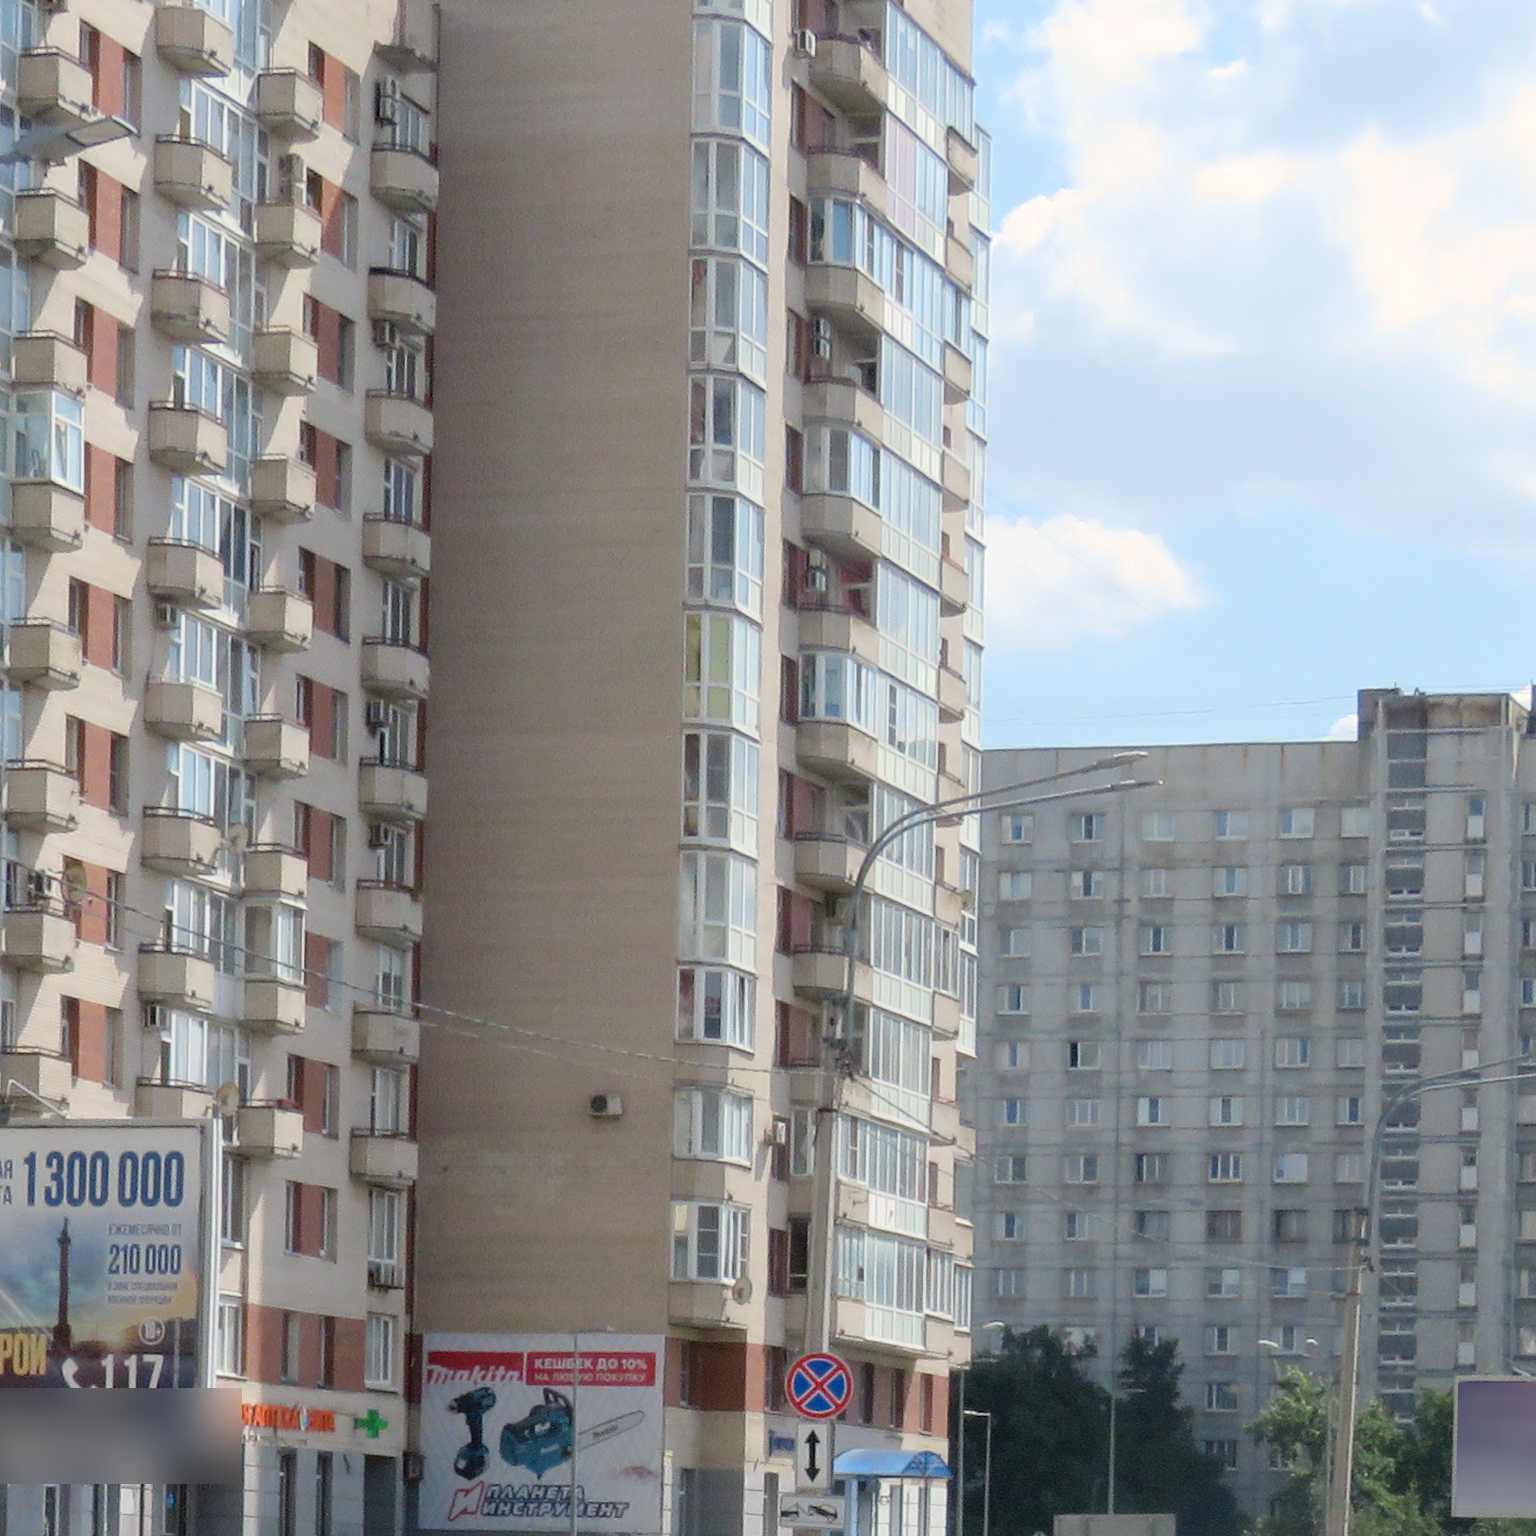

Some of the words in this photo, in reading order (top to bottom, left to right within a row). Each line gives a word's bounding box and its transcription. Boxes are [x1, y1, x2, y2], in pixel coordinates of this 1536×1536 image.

[108, 1244, 140, 1275] 210
[145, 1244, 182, 1275] 000
[101, 1353, 165, 1388] 117
[534, 1357, 593, 1370] КЕШБЕК
[596, 1357, 619, 1371] ДО
[622, 1357, 648, 1370] 10%
[484, 1483, 585, 1500] ПЛАНЕТА
[479, 1501, 630, 1519] ИНСТРУМЕНТ
